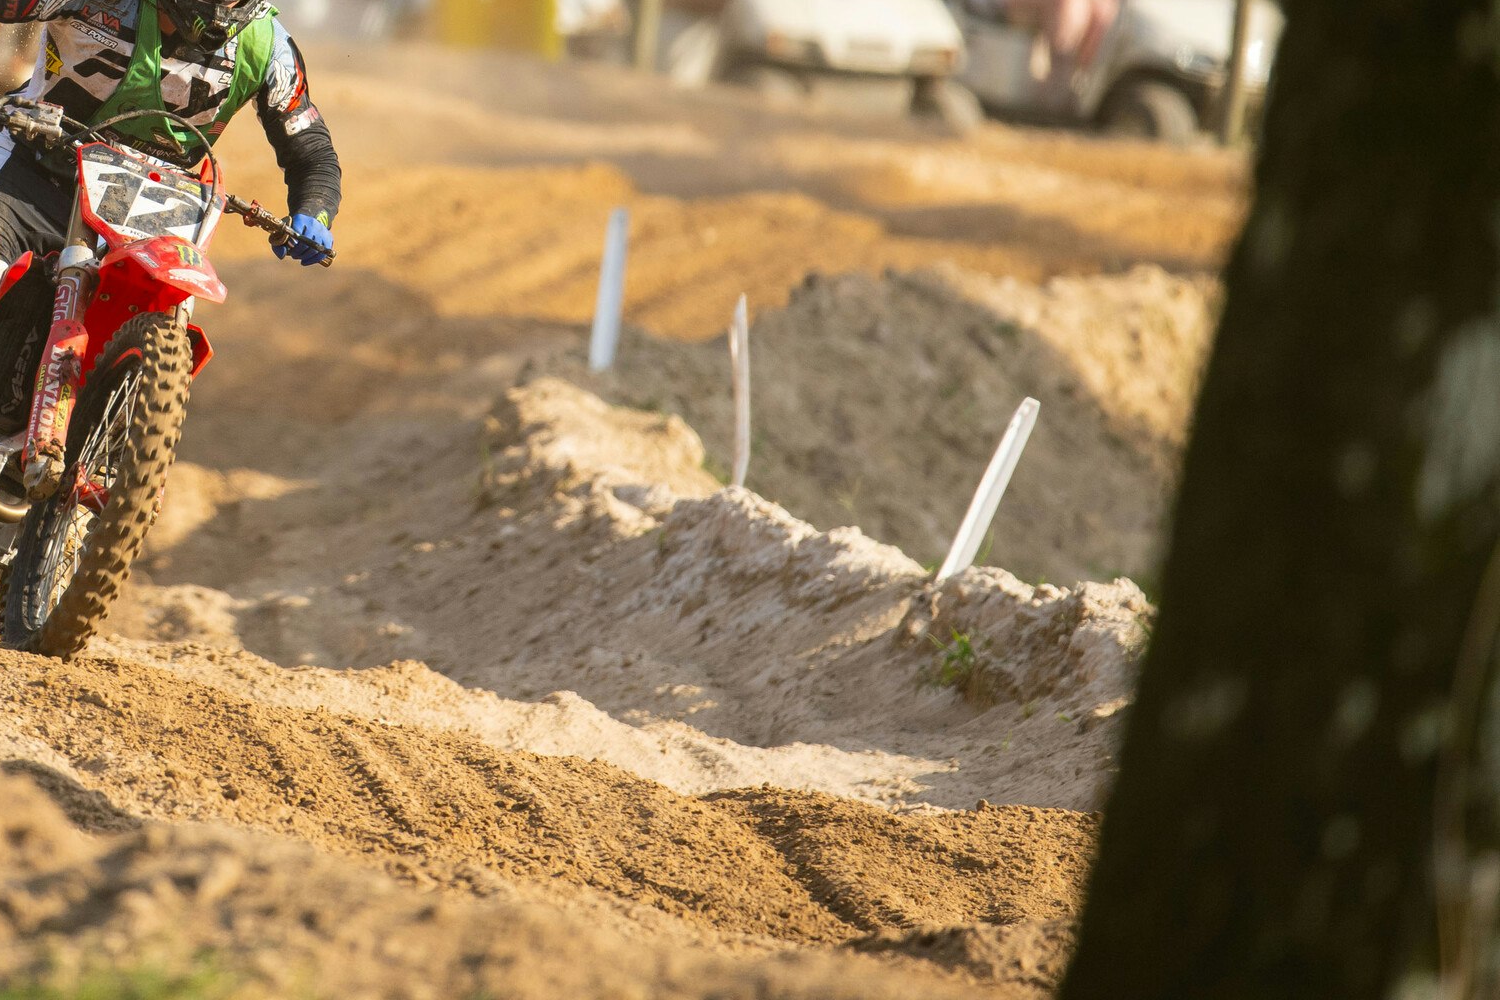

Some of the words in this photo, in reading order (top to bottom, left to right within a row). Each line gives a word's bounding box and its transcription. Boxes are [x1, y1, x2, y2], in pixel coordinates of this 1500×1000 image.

[82, 5, 120, 31] LAVA
[87, 30, 118, 49] POWER
[96, 172, 206, 238] 12
